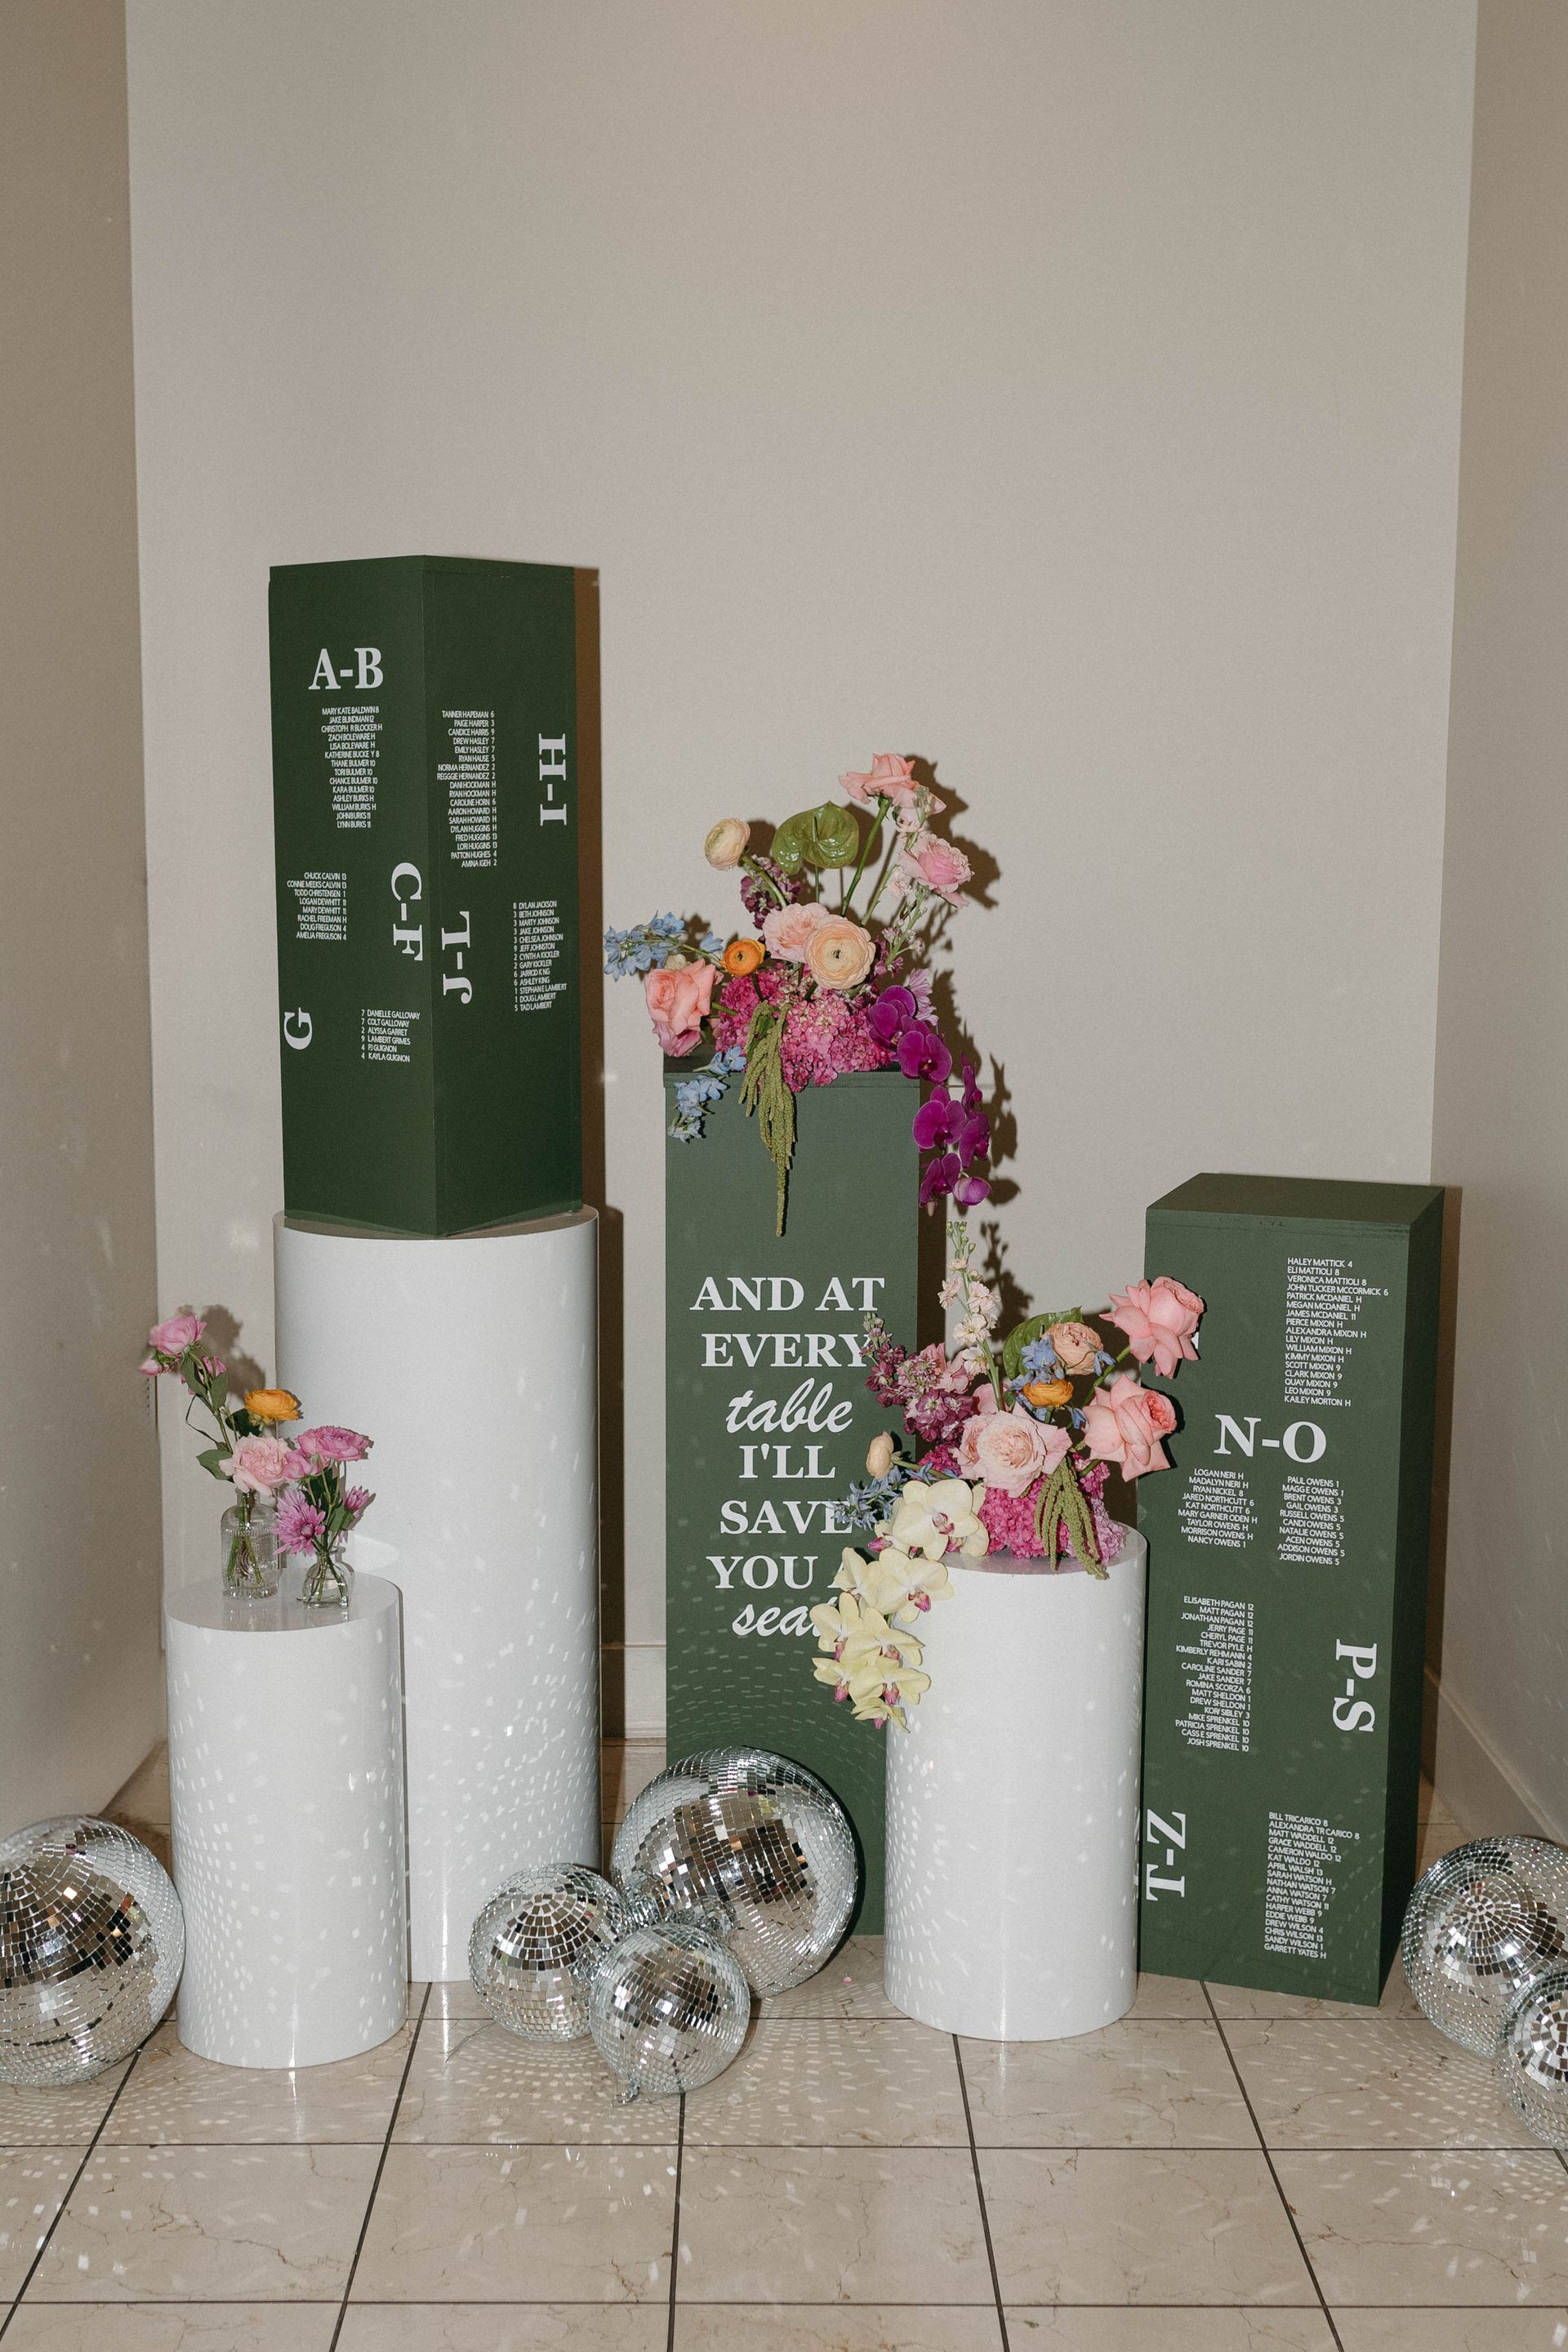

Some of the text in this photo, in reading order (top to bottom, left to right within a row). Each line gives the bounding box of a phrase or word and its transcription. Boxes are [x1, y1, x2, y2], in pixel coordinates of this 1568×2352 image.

[308, 647, 384, 690] A-B
[538, 733, 567, 826] H-I
[390, 862, 423, 961] C-F
[441, 911, 473, 1004] J-L
[283, 1007, 314, 1051] G
[381, 1019, 409, 1027] GALLOWAY
[1288, 1258, 1312, 1266] HALEY
[1313, 1258, 1345, 1267] MATTICK
[1287, 1275, 1325, 1284] VERONICA
[1325, 1277, 1360, 1285] MATTIOLI
[690, 1276, 884, 1311] AND AT
[1287, 1284, 1307, 1292] JOHN
[1307, 1285, 1336, 1293] TUCKER
[1337, 1286, 1381, 1295] MCCORMICK
[1287, 1292, 1315, 1301] PATRICK
[1316, 1294, 1353, 1303] MCDANIEL
[1286, 1327, 1332, 1336] ALEXANDRA
[1334, 1330, 1358, 1338] MIXON
[701, 1333, 869, 1367] EVERY
[1286, 1344, 1318, 1352] WILLIAM
[1319, 1346, 1343, 1354] MIXON
[1285, 1361, 1308, 1370] SCOTT
[1309, 1363, 1334, 1371] MIXON
[725, 1377, 853, 1433] table
[1285, 1396, 1310, 1404] KAILEY
[1311, 1396, 1343, 1405] MORTON
[1214, 1414, 1327, 1463] N-O
[738, 1443, 835, 1478] I'LL
[1194, 1468, 1219, 1477] LOGAN
[1220, 1471, 1236, 1479] NERI
[1189, 1477, 1224, 1486] MADALYN
[1225, 1480, 1241, 1488] NERI
[1288, 1476, 1306, 1485] PAUL
[1307, 1478, 1334, 1487] OWENS
[1183, 1493, 1205, 1501] JARED
[1205, 1495, 1247, 1505] NORTHCUTT
[1284, 1493, 1307, 1502] BRENT
[1307, 1495, 1334, 1504] OWENS
[1200, 1503, 1243, 1513] NORTHCUTT
[719, 1500, 853, 1535] SAVE
[1178, 1509, 1199, 1518] MARY
[1200, 1512, 1228, 1521] GARNER
[1229, 1514, 1250, 1522] ODEN
[1280, 1510, 1309, 1519] RUSSELL
[1310, 1512, 1337, 1521] OWENS
[1187, 1518, 1213, 1527] TAYLOR
[1214, 1521, 1241, 1530] OWENS
[1181, 1526, 1218, 1536] MORRISON
[1218, 1530, 1245, 1539] OWENS
[1279, 1527, 1308, 1536] NATALIE
[1309, 1530, 1337, 1539] OWENS
[1187, 1536, 1213, 1544] NANCY
[1214, 1539, 1241, 1548] OWENS
[706, 1555, 818, 1589] YOU
[732, 1598, 836, 1637] sea
[1200, 1606, 1219, 1615] MATT
[1221, 1609, 1245, 1618] PAGAN
[1207, 1624, 1228, 1633] JERRY
[1228, 1626, 1245, 1634] PAGE
[1200, 1640, 1227, 1650] TREVOR
[1228, 1643, 1245, 1651] PYLE
[1182, 1663, 1215, 1673] CAROLINE
[1217, 1666, 1245, 1676] SANDER
[1332, 1638, 1378, 1732] P-S
[1192, 1689, 1212, 1698] MATT
[1213, 1691, 1245, 1702] SHELDON
[1189, 1713, 1205, 1722] MIKE
[1206, 1715, 1241, 1725] SPRENKEL
[1269, 1812, 1284, 1820] BILL
[1285, 1815, 1321, 1825] TRICARICO
[1268, 1838, 1292, 1846] GRACE
[1294, 1841, 1327, 1851] WADDELL
[1146, 1809, 1186, 1901] T-Z
[1268, 1845, 1304, 1856] CAMERON
[1305, 1851, 1333, 1860] WALDO
[1267, 1869, 1292, 1879] SARAH
[1294, 1873, 1324, 1883] WATSON
[1266, 1911, 1286, 1920] EDDIE
[1287, 1913, 1307, 1923] WEBB
[1265, 1918, 1288, 1928] DREW
[1289, 1922, 1316, 1932] WILSON
[1264, 1944, 1298, 1954] GARRETT
[1298, 1948, 1318, 1958] YATES
